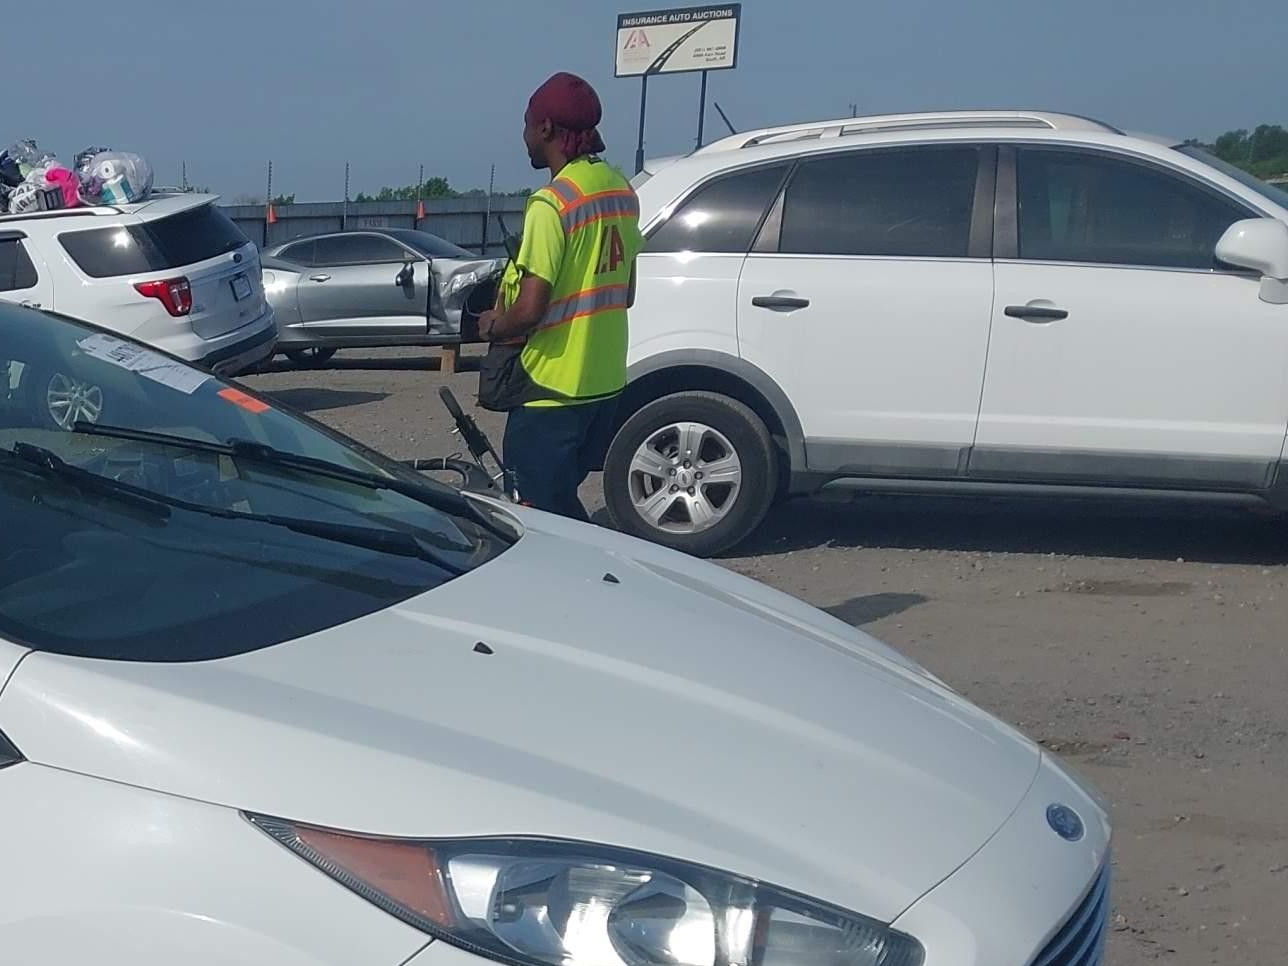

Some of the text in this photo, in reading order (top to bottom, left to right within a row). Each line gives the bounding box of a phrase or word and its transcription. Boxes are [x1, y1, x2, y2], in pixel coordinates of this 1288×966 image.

[622, 9, 733, 26] INSURANCE AUTO AUCTIONS
